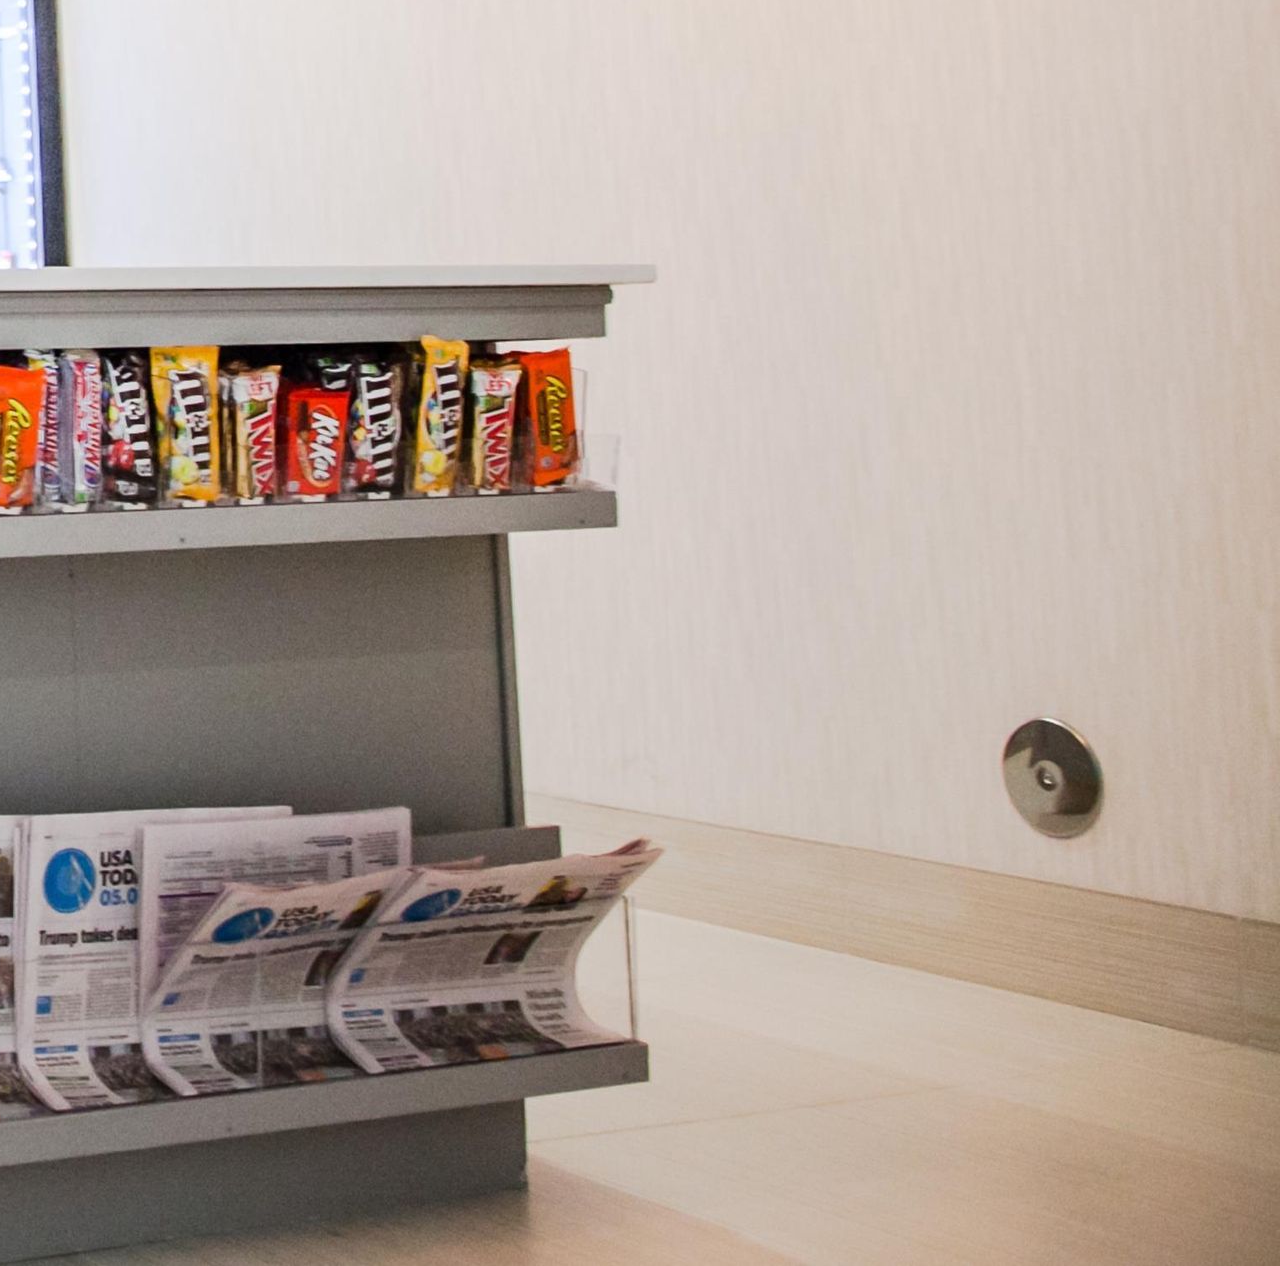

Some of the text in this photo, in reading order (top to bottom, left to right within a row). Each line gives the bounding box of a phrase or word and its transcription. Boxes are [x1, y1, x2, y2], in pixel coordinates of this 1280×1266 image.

[247, 401, 277, 495] TWIX
[485, 401, 514, 488] TWIX
[100, 850, 133, 867] USA
